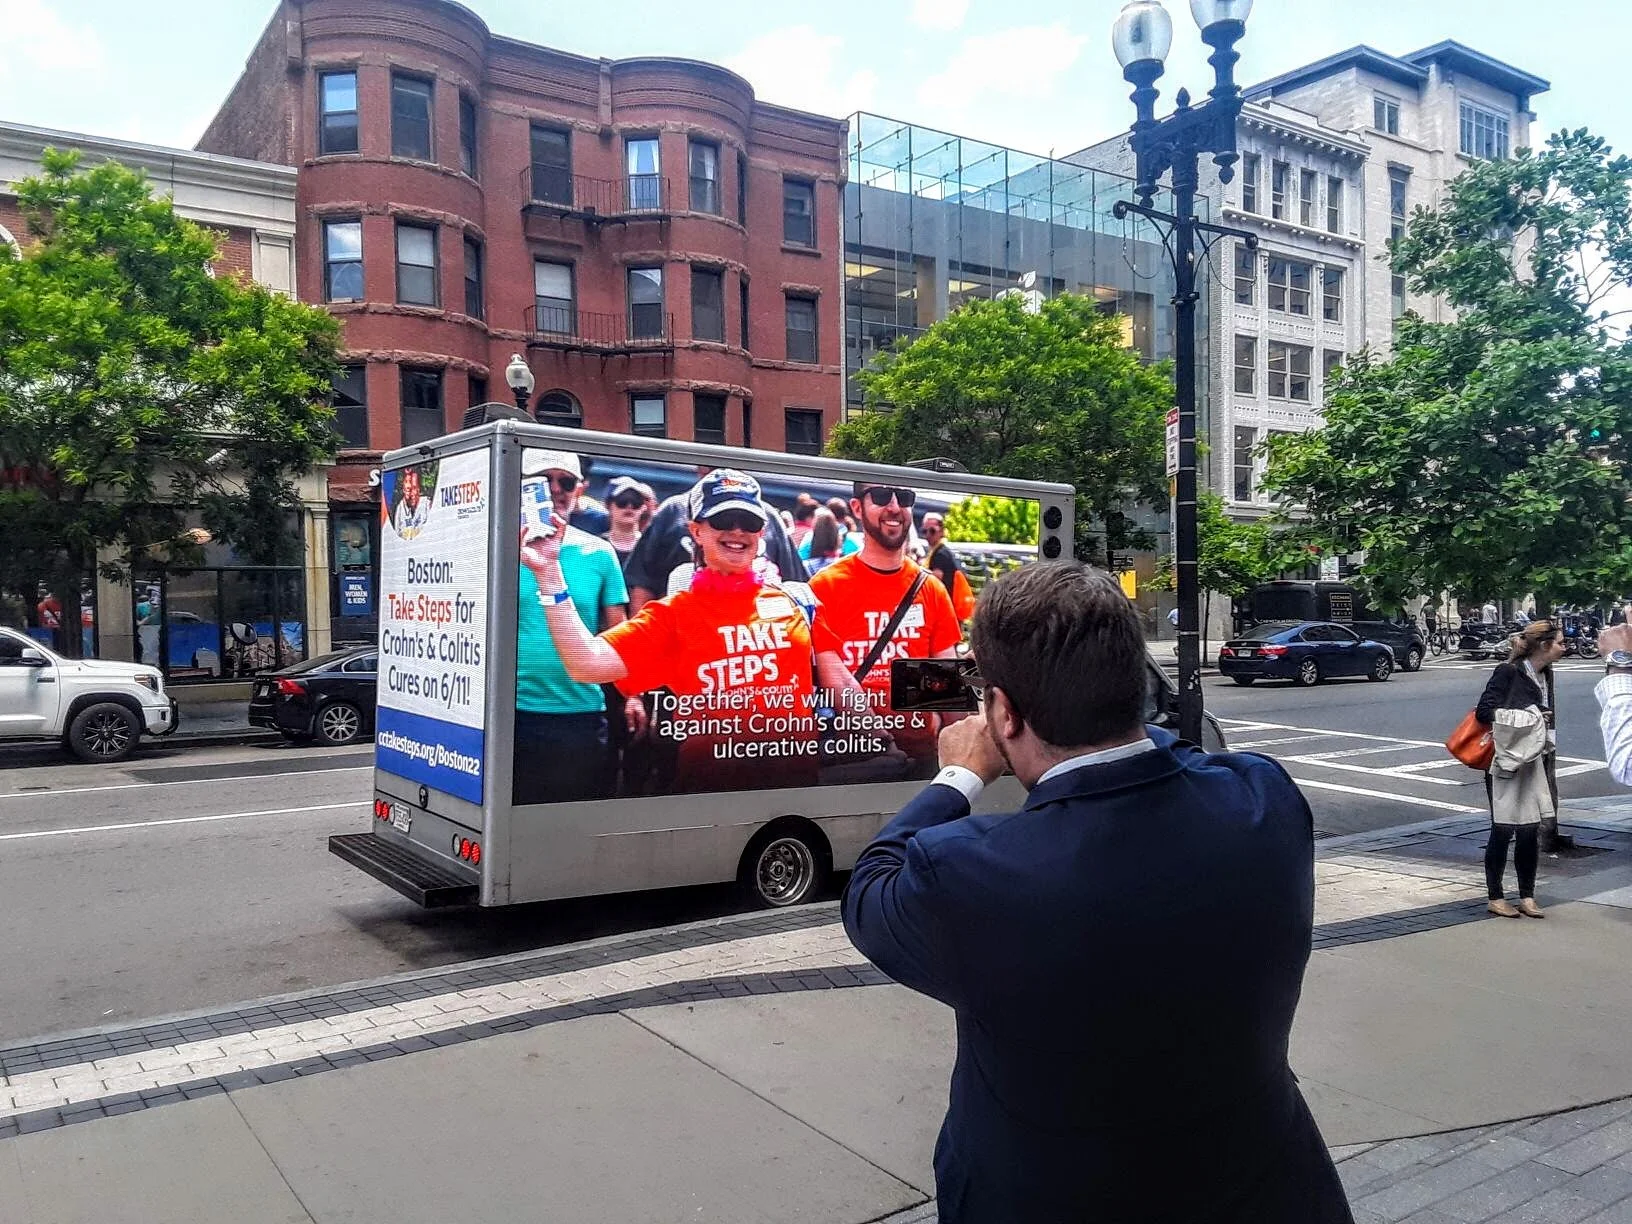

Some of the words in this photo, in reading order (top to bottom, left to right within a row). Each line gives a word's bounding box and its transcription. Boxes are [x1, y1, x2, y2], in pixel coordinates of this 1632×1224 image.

[407, 557, 453, 584] Boston:
[388, 592, 415, 621] Take
[417, 594, 452, 630] Steps
[455, 592, 475, 624] for
[382, 628, 424, 659] Crohn's
[426, 632, 437, 660] &
[439, 633, 481, 666] Colitis
[717, 622, 792, 654] TAKE
[388, 665, 420, 696] Cures
[422, 676, 438, 700] on
[441, 672, 471, 710] 6/11!
[697, 652, 779, 694] STEPS
[648, 688, 757, 716] Together,
[763, 693, 795, 709] we
[801, 688, 834, 708] will
[841, 687, 887, 712] fight
[660, 714, 742, 740] against
[833, 711, 905, 731] disease
[910, 711, 925, 729] &
[378, 730, 480, 776] cctakesteps.org/Boston22
[713, 737, 818, 759] ulcerative
[824, 734, 887, 754] colitis.
